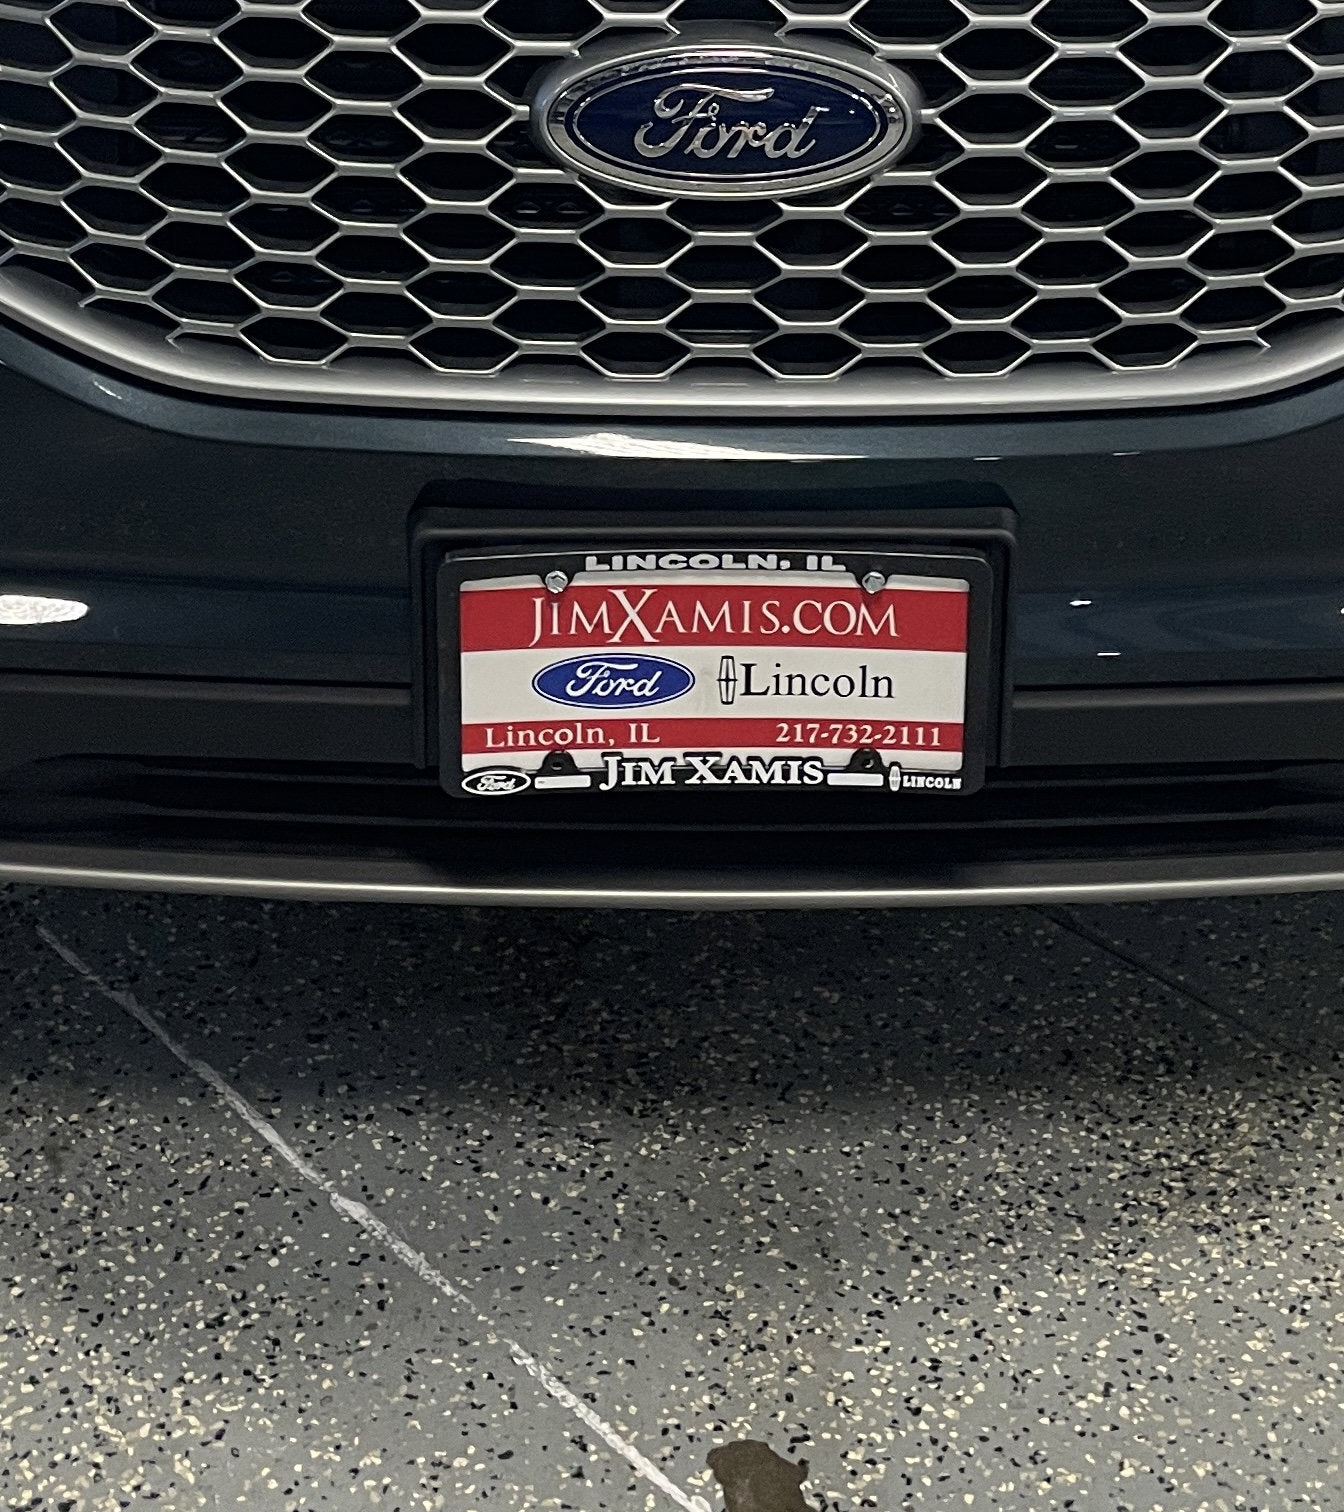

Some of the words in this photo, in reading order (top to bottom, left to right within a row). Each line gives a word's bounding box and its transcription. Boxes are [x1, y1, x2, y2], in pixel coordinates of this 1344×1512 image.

[806, 554, 847, 572] IL
[528, 588, 899, 648] JIMXAMIS.COM
[739, 662, 896, 700] Lincoln
[484, 722, 616, 749] Lincoln,
[628, 722, 661, 744] IL
[775, 722, 942, 747] 217-732-2111
[598, 755, 676, 792] JIM
[684, 755, 825, 786] XAMIS
[902, 774, 962, 790] LINCOLN
